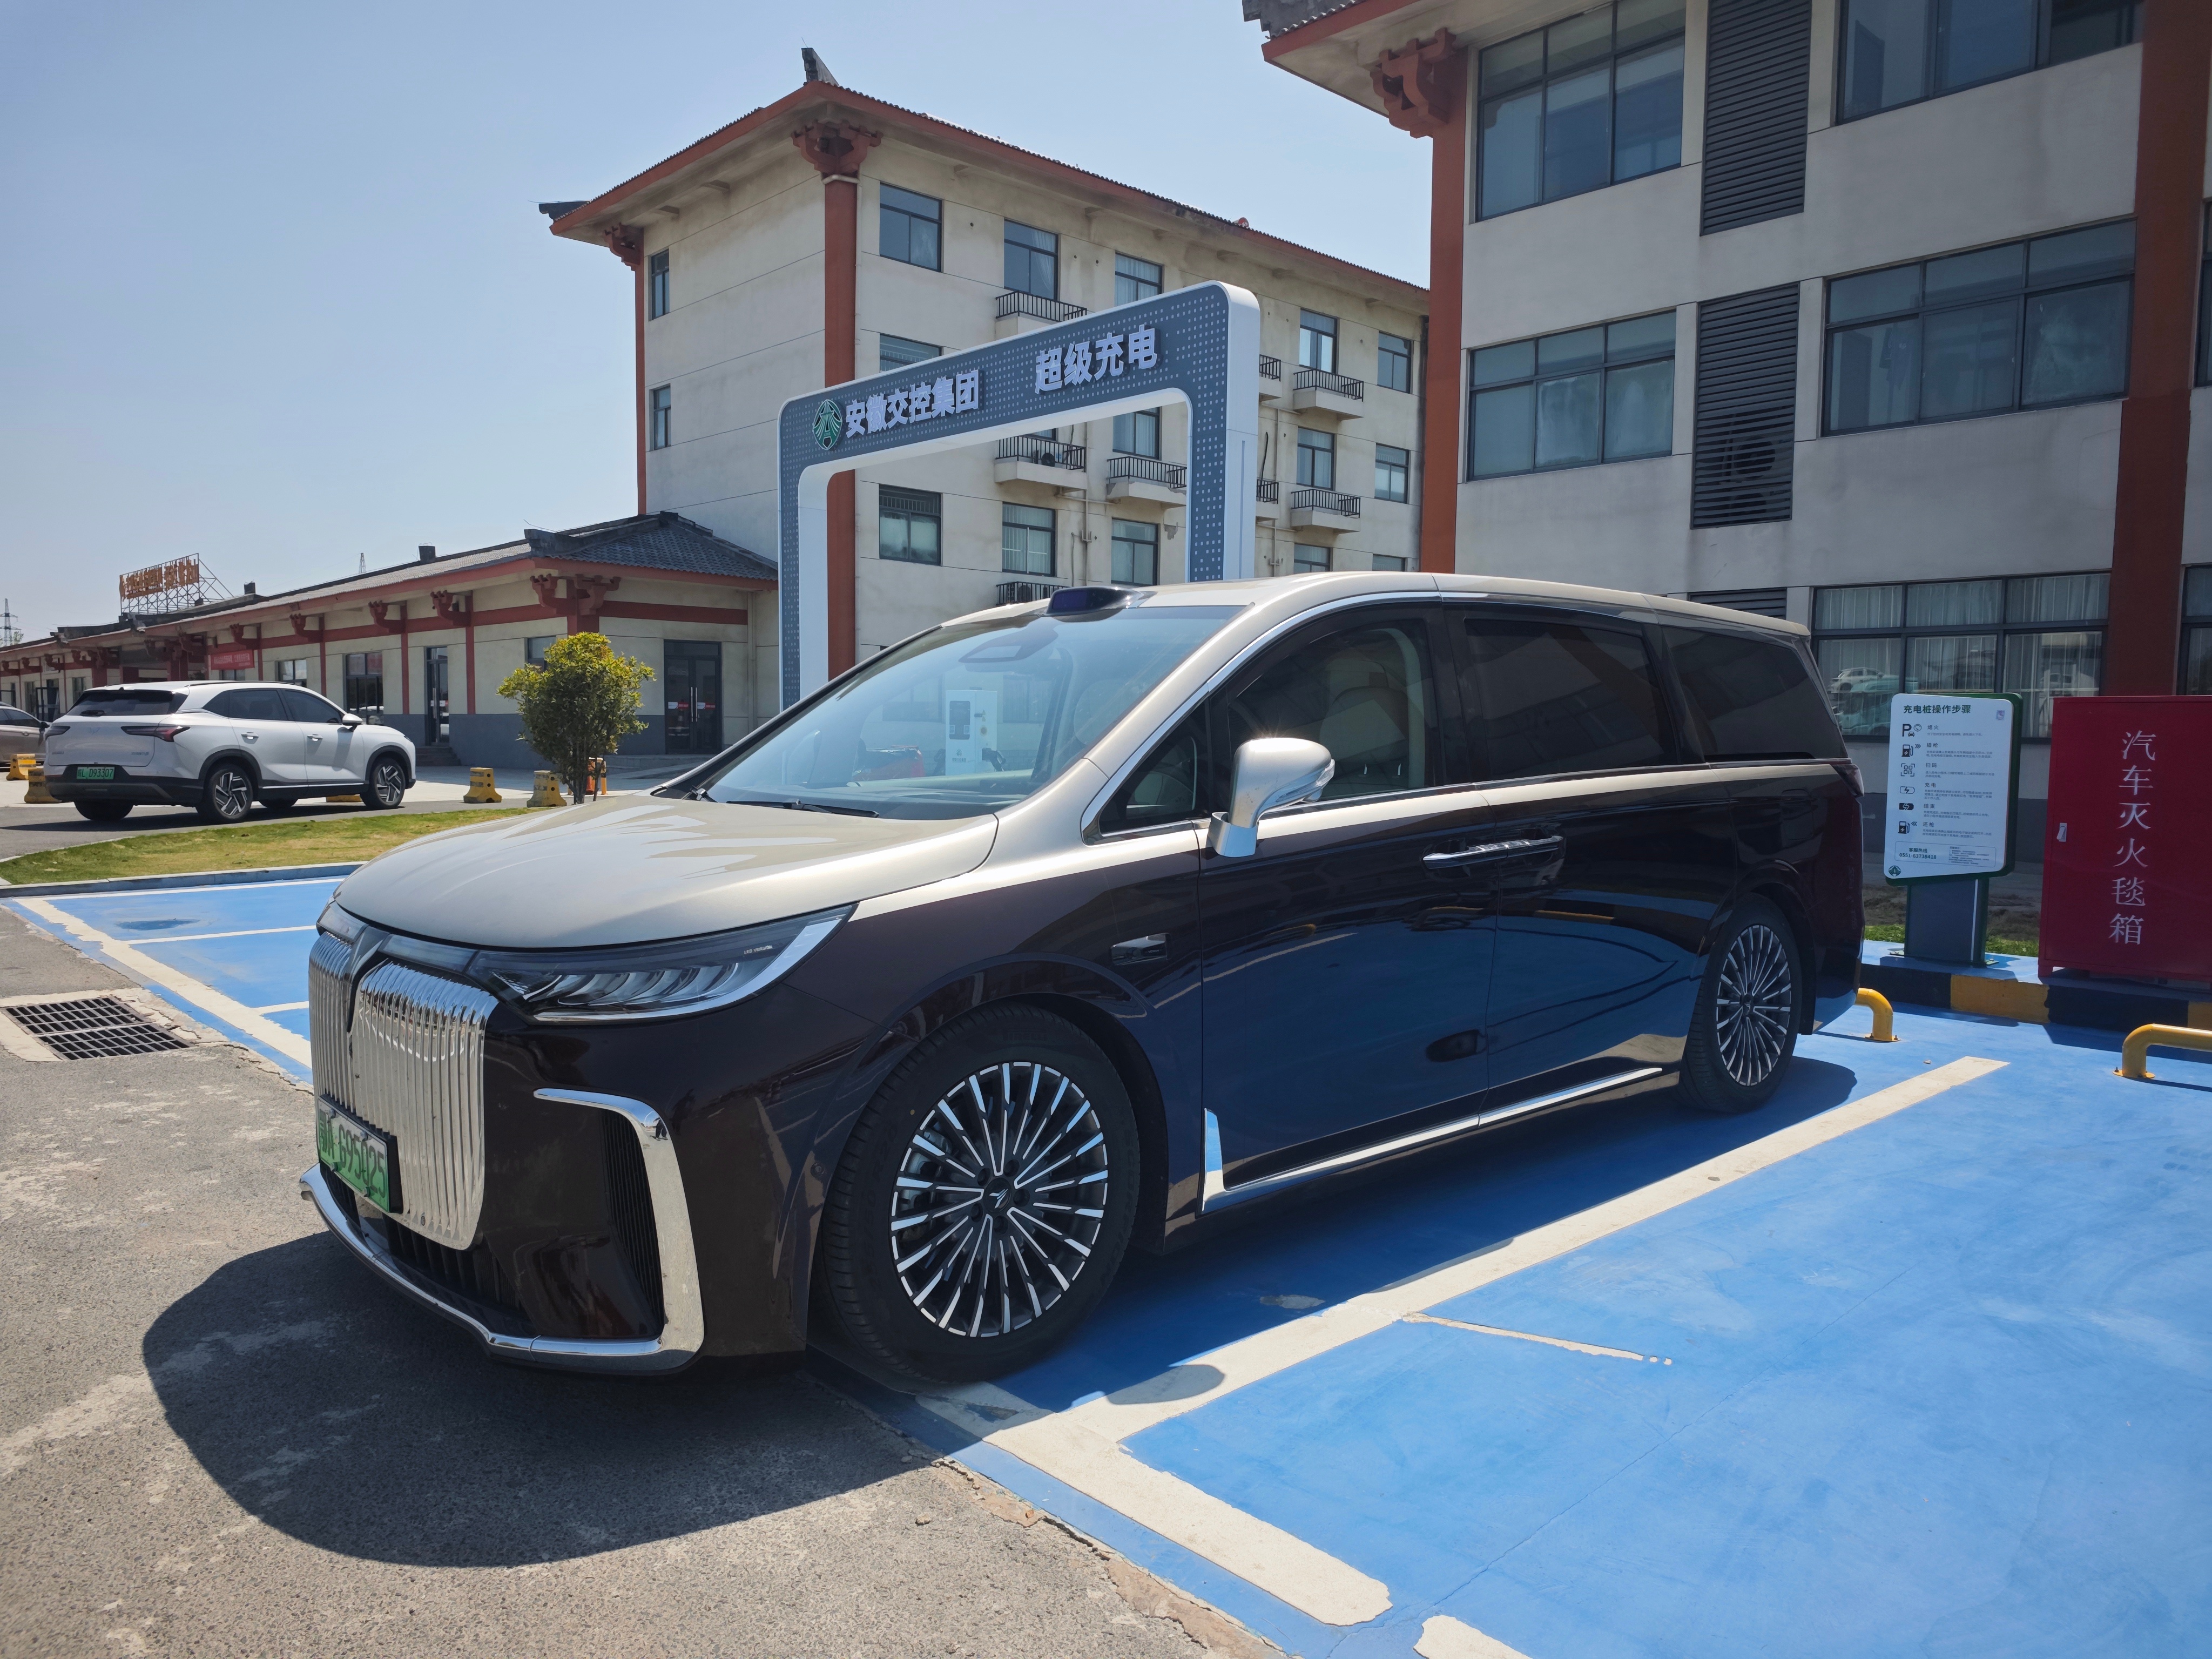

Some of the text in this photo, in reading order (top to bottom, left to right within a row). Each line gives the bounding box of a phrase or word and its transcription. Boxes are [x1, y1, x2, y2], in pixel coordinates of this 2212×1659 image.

[845, 324, 1157, 438] 安徽交控集团 超级充电
[1903, 704, 1971, 714] 充电桩操作步骤
[89, 768, 114, 778] D93307
[2108, 730, 2157, 945] 汽车灭火毯箱
